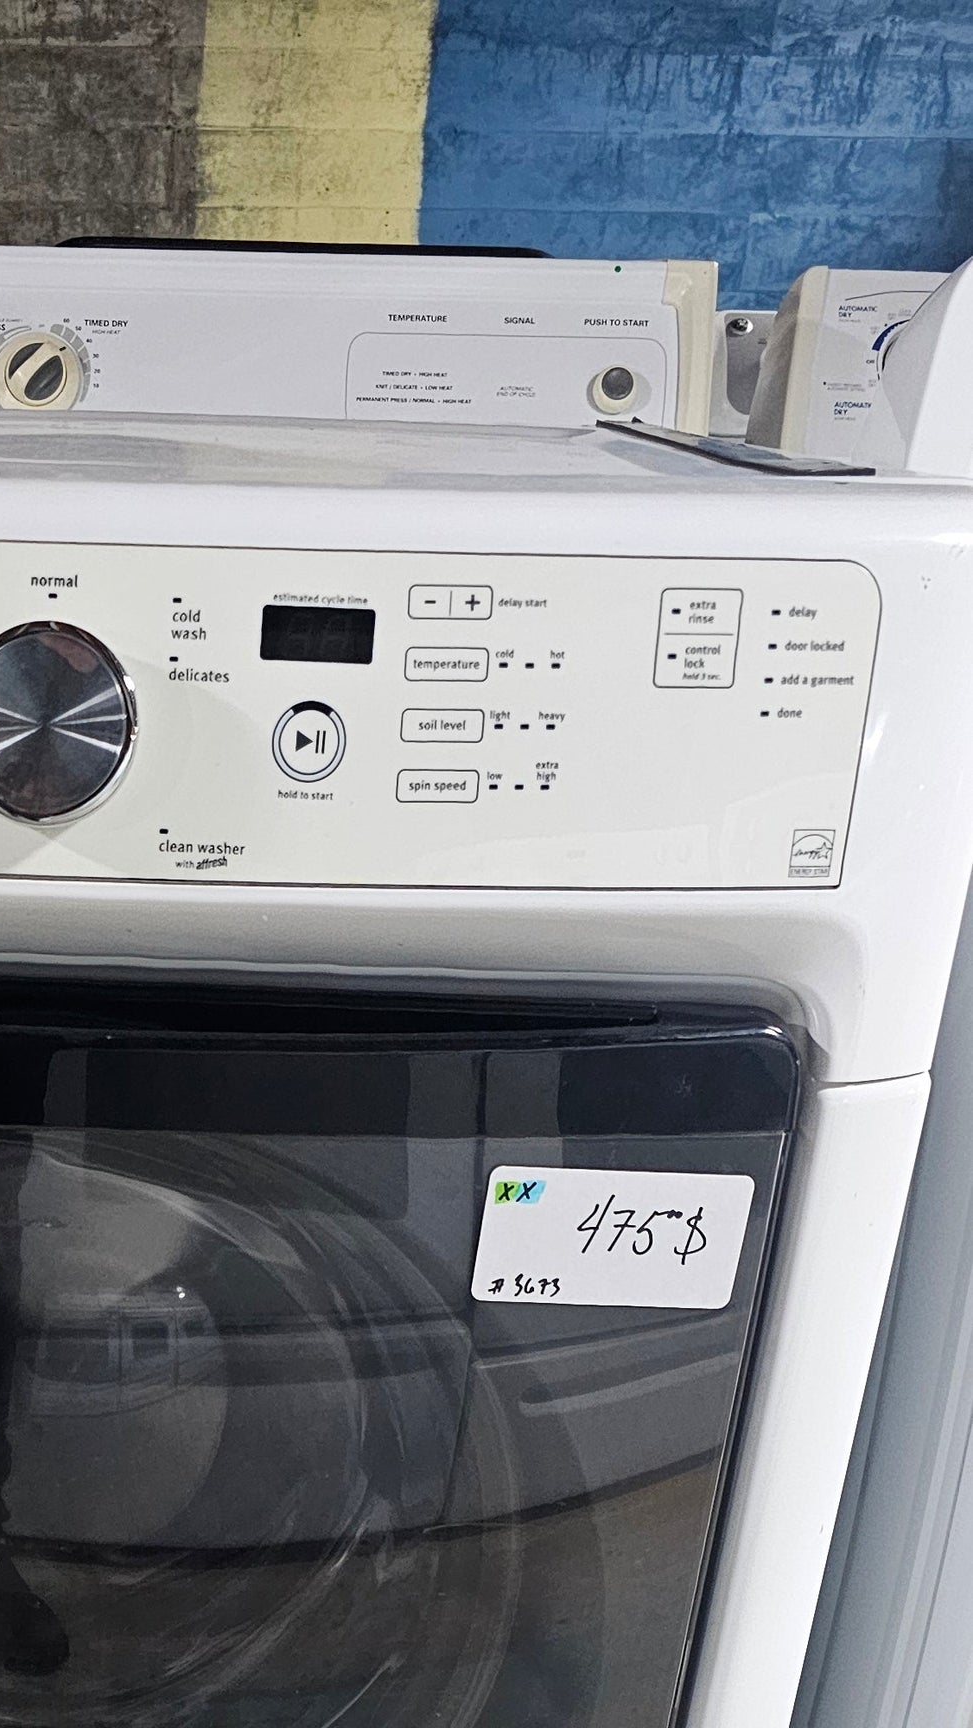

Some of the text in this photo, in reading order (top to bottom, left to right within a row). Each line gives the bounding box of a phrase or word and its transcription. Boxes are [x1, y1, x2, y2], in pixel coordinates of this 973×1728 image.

[85, 319, 129, 328] TIMED DRY
[388, 314, 448, 323] TEMPERATURE
[504, 316, 535, 325] SIGNAL
[584, 318, 649, 328] PUSH TO START
[31, 574, 78, 589] normal
[273, 593, 368, 605] estimated cycle time
[498, 597, 547, 608] delay start
[689, 601, 716, 610] extra
[172, 609, 201, 624] cold
[688, 613, 714, 624] rinse
[789, 606, 817, 620] delay
[171, 626, 207, 641] wash
[685, 644, 721, 655] control
[784, 640, 845, 651] door locked
[495, 649, 565, 659] cold hot
[413, 658, 480, 672] temperature
[684, 658, 705, 669] lock
[169, 667, 230, 684] delicates
[781, 675, 854, 688] add a garment
[490, 710, 566, 723] light heavy
[777, 707, 803, 718] done
[418, 719, 466, 731] soil level
[535, 760, 559, 770] extra
[487, 771, 557, 782] low high
[408, 779, 467, 793] spin speed
[277, 789, 334, 801] hold to start
[159, 839, 245, 855] clean washer
[175, 860, 195, 869] with
